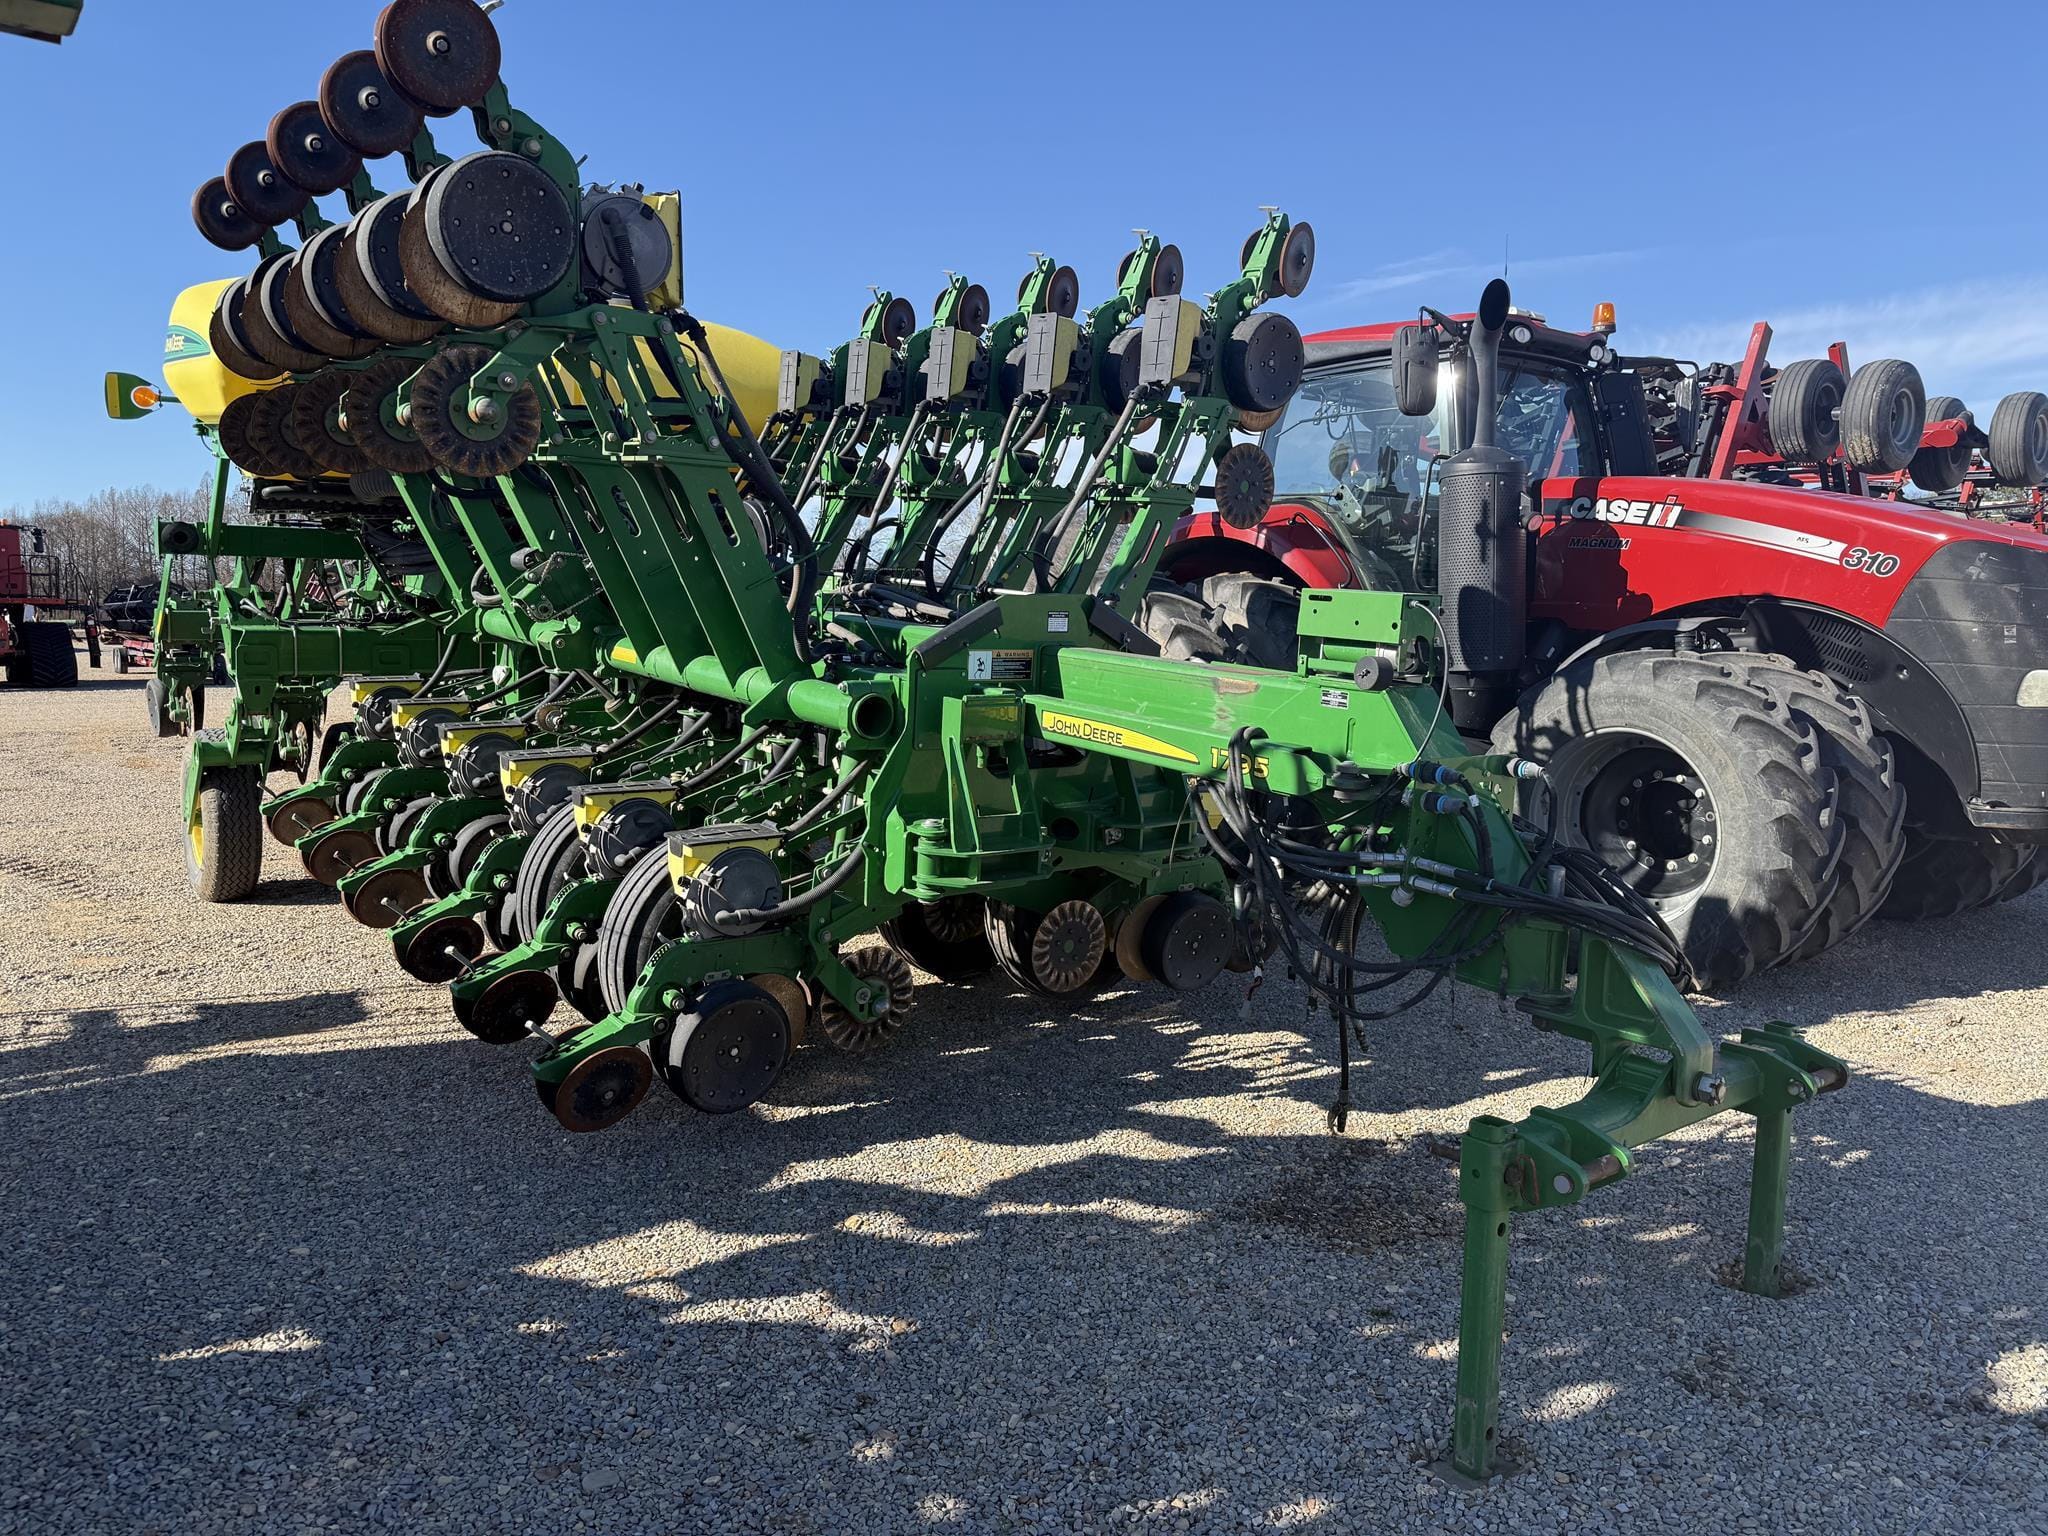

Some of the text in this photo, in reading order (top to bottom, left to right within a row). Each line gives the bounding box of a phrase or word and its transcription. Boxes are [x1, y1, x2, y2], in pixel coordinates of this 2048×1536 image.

[1570, 497, 1650, 524] CASE
[1568, 537, 1631, 550] MAGNUM
[1843, 547, 1900, 577] 310
[1050, 716, 1123, 744] JOHN DEERE
